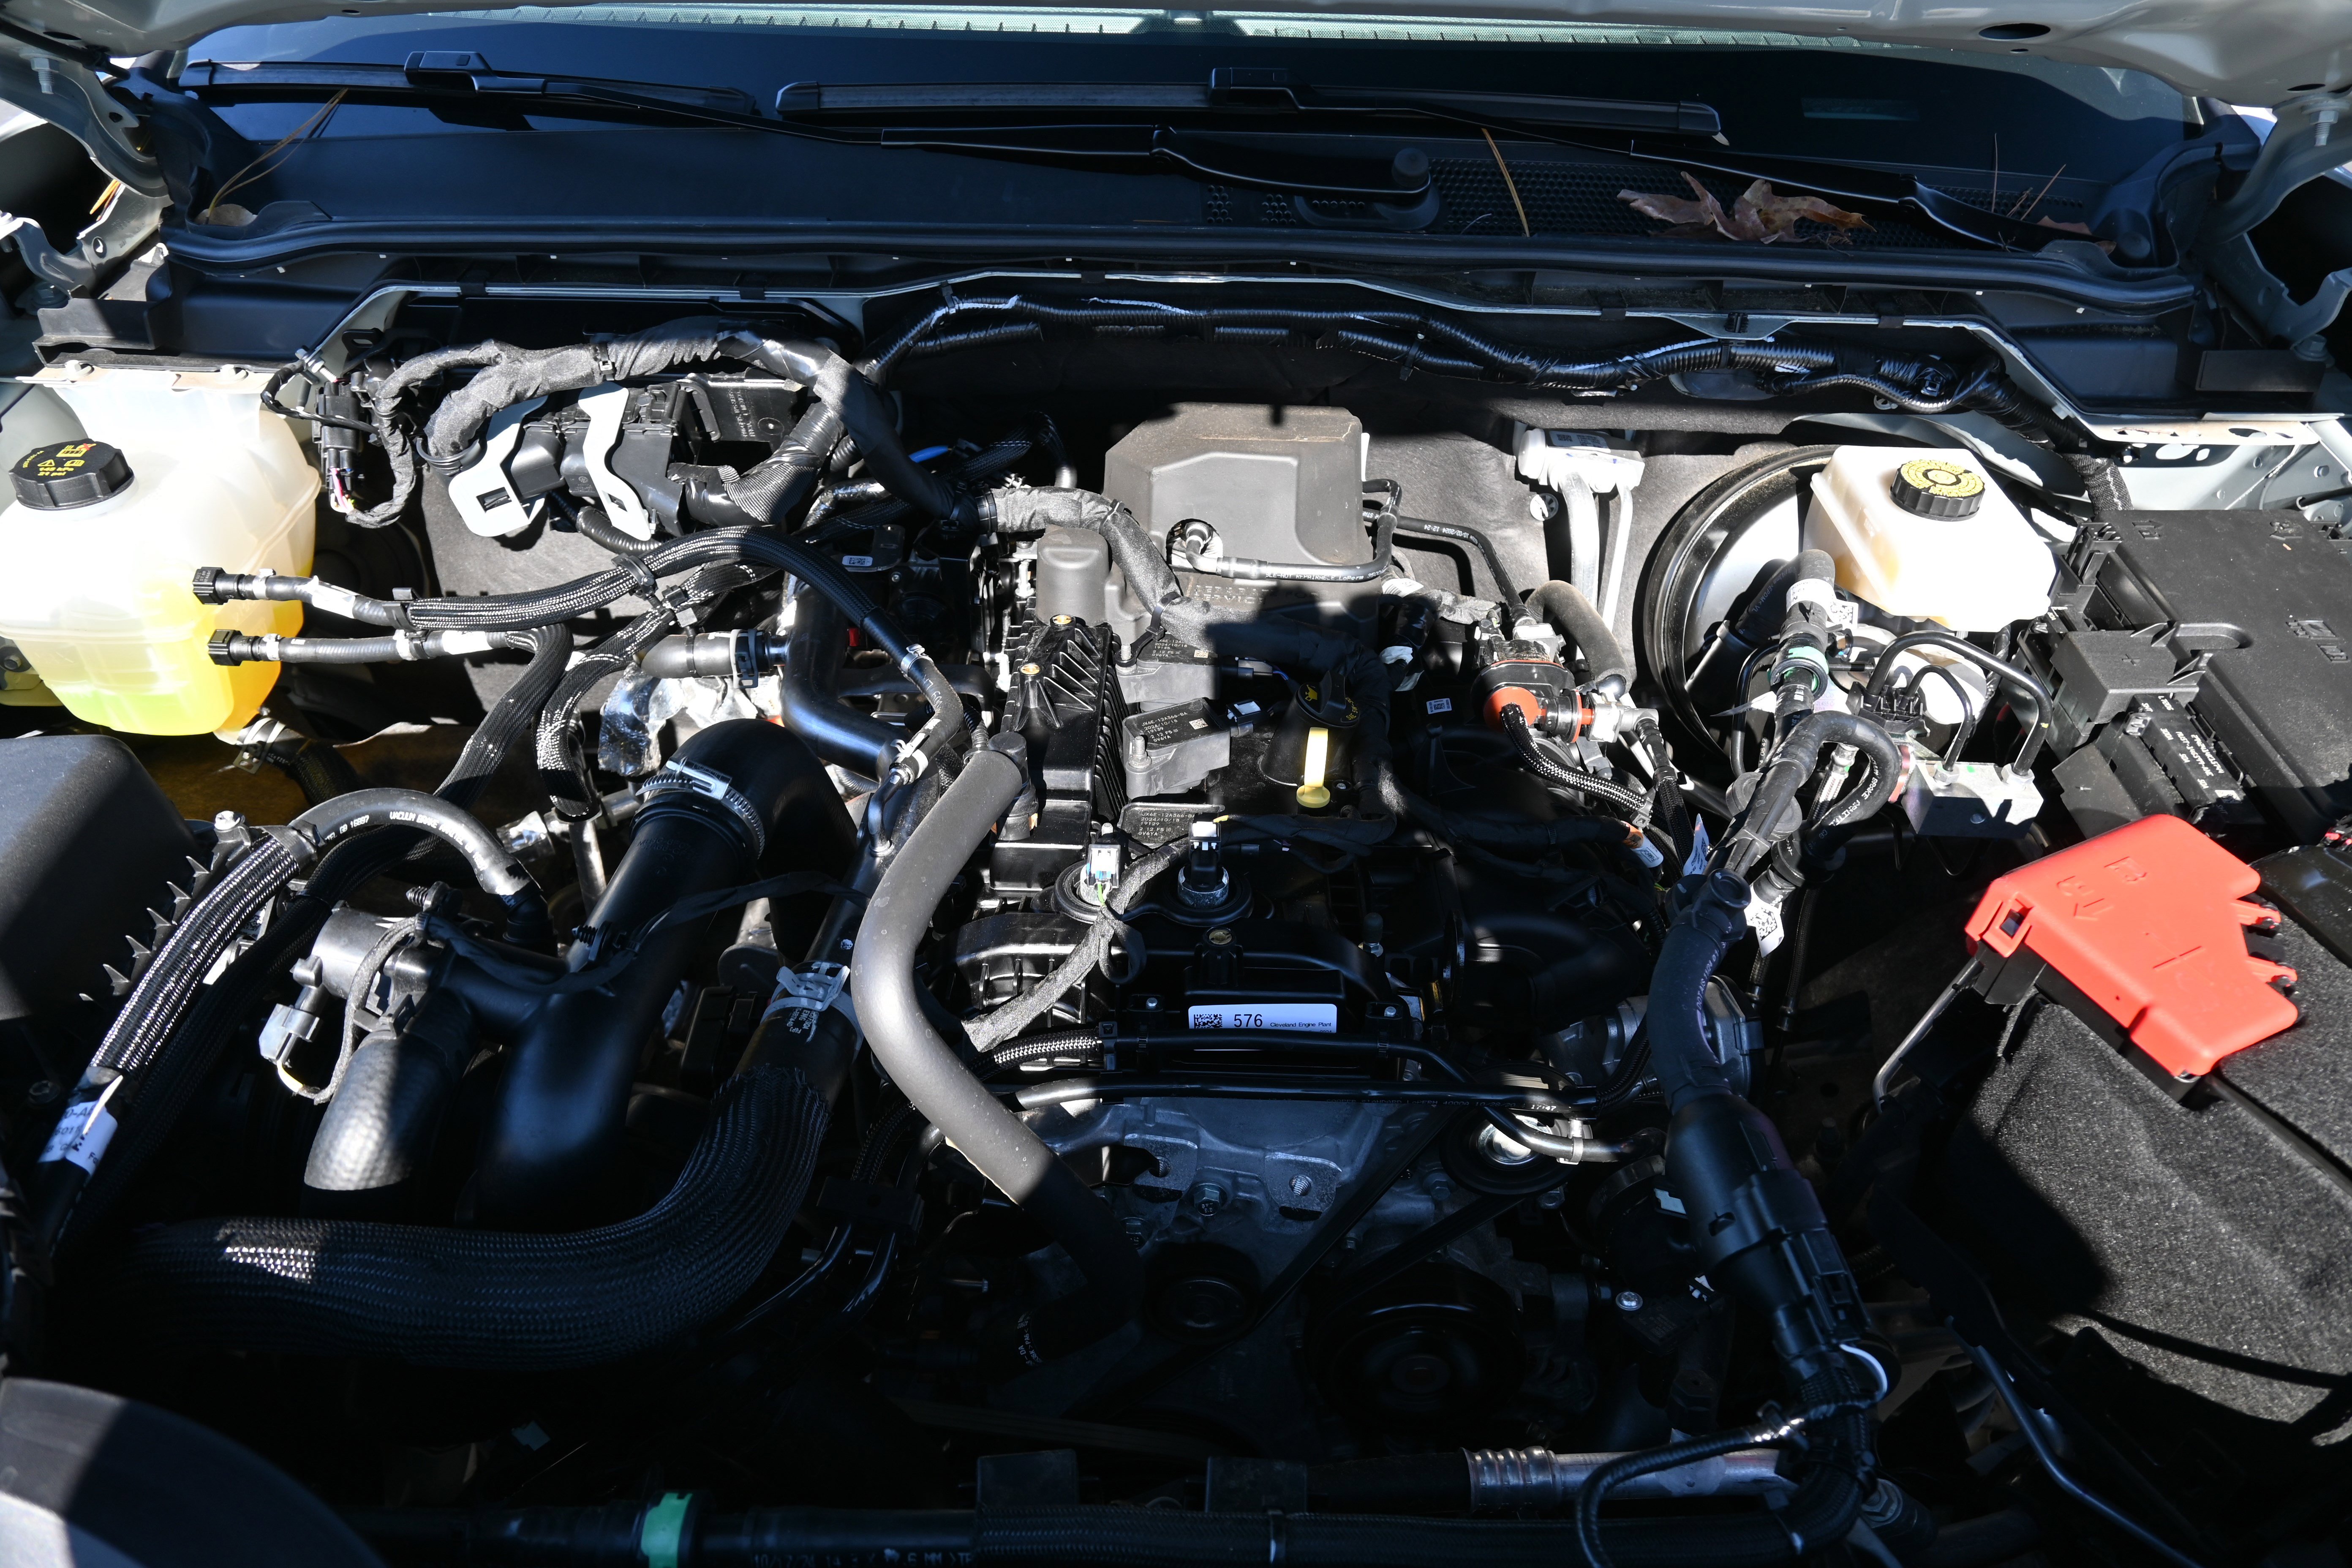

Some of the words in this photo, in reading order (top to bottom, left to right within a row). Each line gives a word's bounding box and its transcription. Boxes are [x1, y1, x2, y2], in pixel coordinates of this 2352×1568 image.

[1424, 524, 1440, 532] 12:24
[1443, 527, 1469, 539] 10/02/2024
[1141, 712, 1187, 726] JX6E-12A366-BA
[1144, 719, 1178, 730] 2024/10/18
[1861, 777, 1878, 800] BRAKE
[390, 811, 416, 821] VACUUM
[416, 814, 439, 828] BRAKE
[1234, 1014, 1263, 1027] 576
